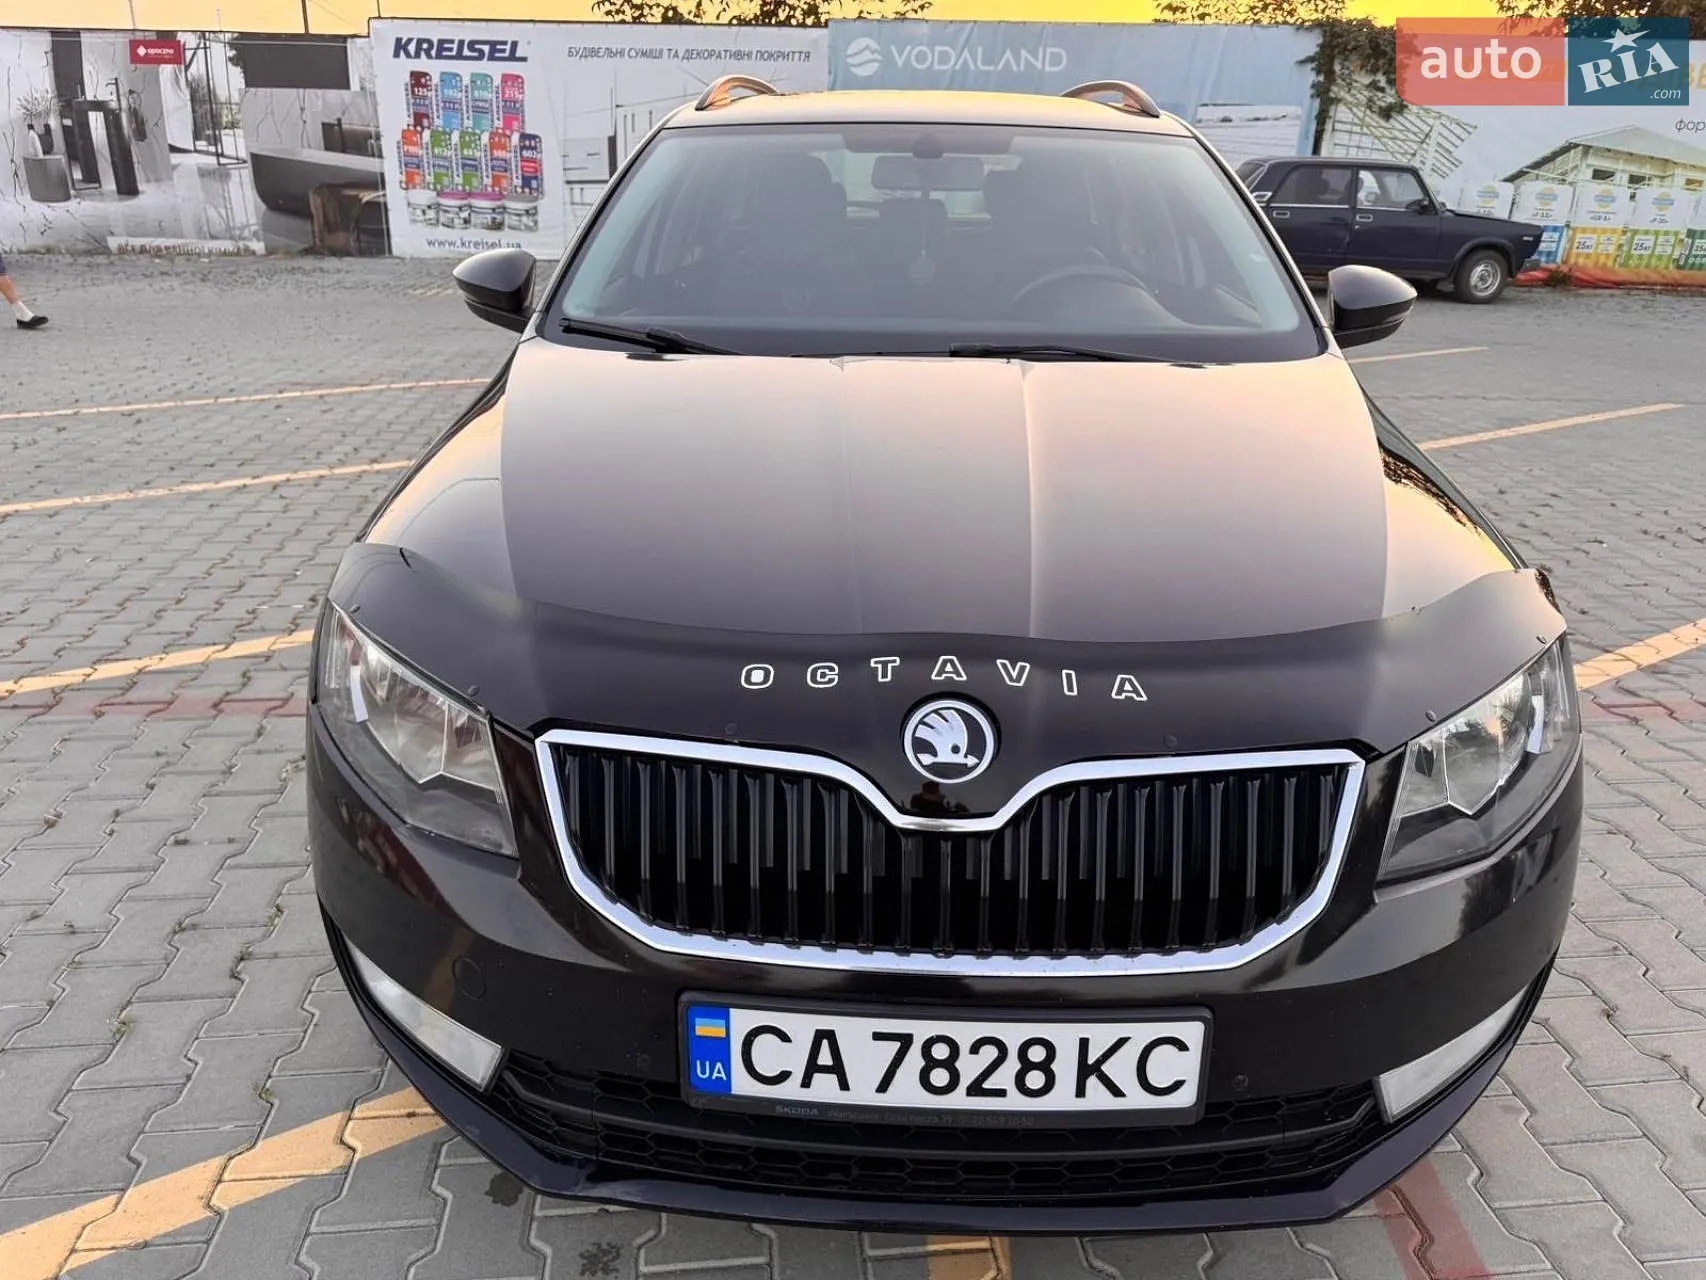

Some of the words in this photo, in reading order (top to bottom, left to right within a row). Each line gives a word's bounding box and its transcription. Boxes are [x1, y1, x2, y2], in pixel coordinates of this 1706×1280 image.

[392, 36, 528, 62] KREISEL
[567, 46, 625, 60] БУДІВЕЛЬНІ
[627, 47, 663, 60] СУМІШІ
[667, 48, 680, 60] ТА
[681, 48, 753, 62] ДЕКОРАТИВНІ
[754, 50, 811, 63] ПОКРИТТЯ
[891, 45, 1068, 72] VODALAND
[741, 655, 1147, 701] OCTAVIA
[696, 1059, 727, 1081] UA
[741, 1024, 850, 1091] CA
[872, 1031, 1057, 1098] 7828
[1075, 1036, 1191, 1098] KC
